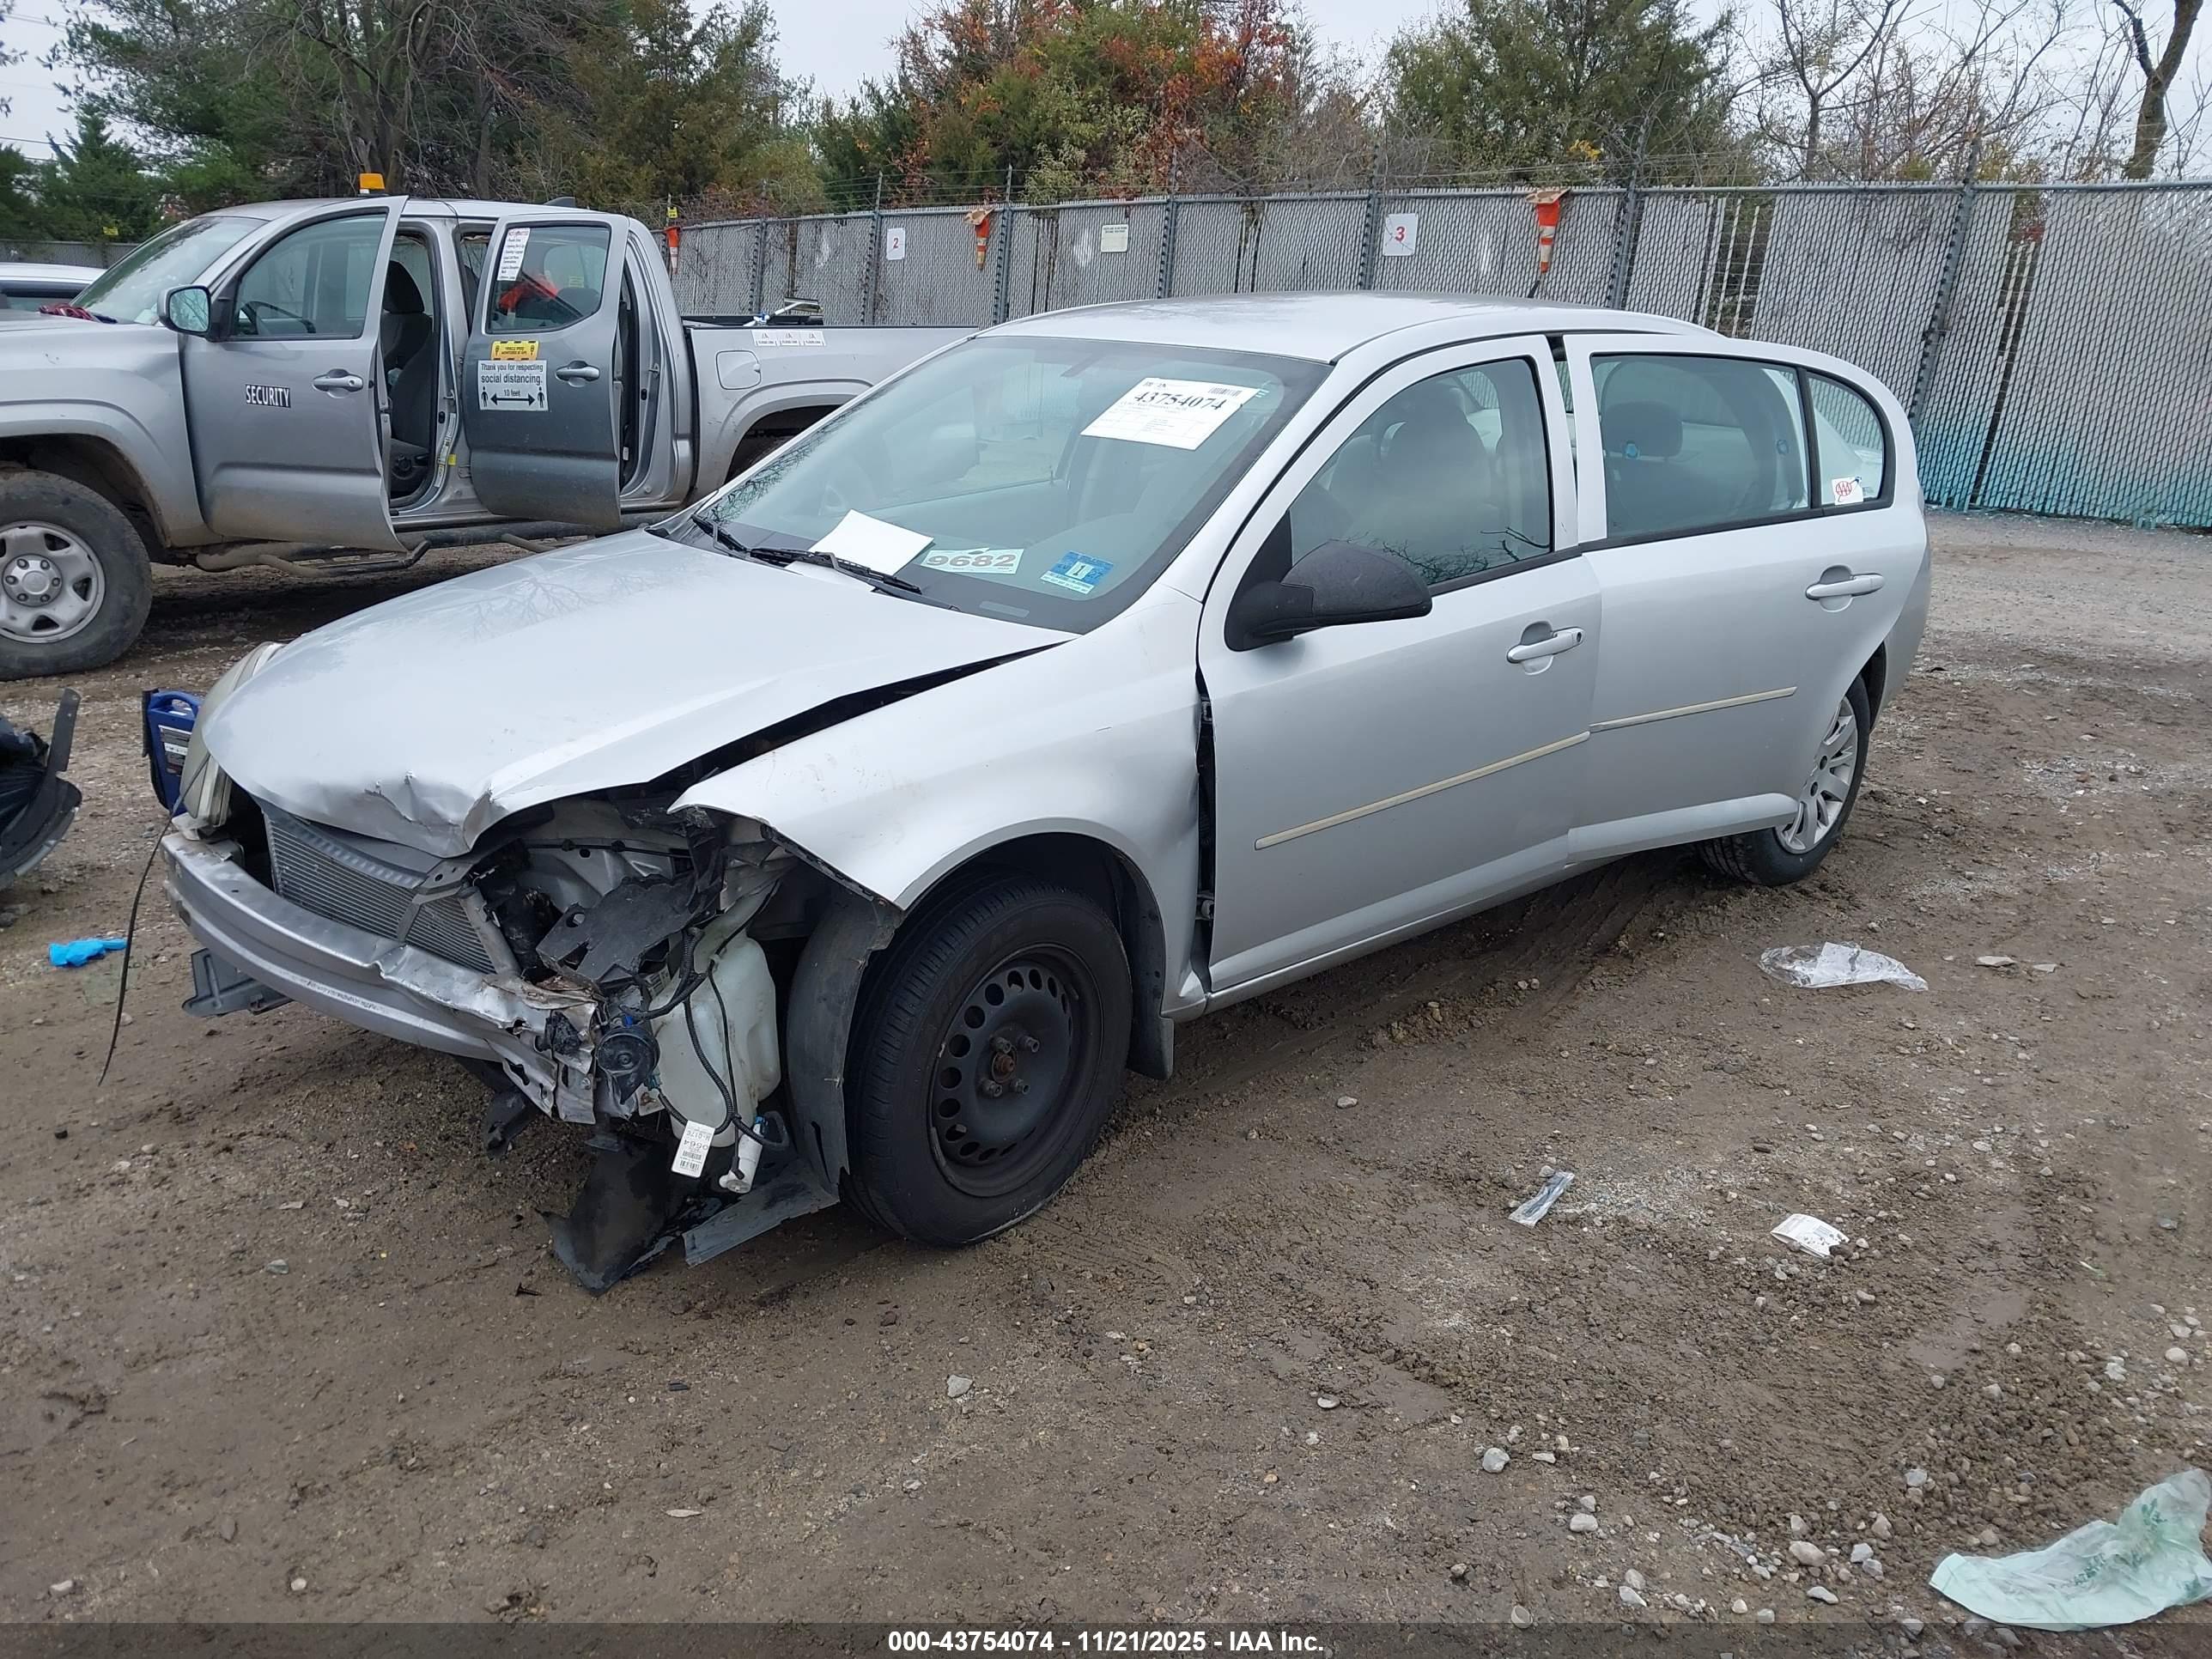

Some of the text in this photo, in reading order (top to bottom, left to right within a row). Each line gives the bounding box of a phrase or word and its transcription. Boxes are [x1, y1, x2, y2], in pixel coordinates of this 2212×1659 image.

[1395, 226, 1406, 241] 3
[893, 237, 899, 249] 2
[516, 364, 544, 373] respecting
[481, 374, 543, 386] social distancing.
[246, 385, 289, 407] SECURITY
[1134, 392, 1227, 410] 43754074
[927, 554, 1017, 568] 9682
[1073, 565, 1086, 576] 1
